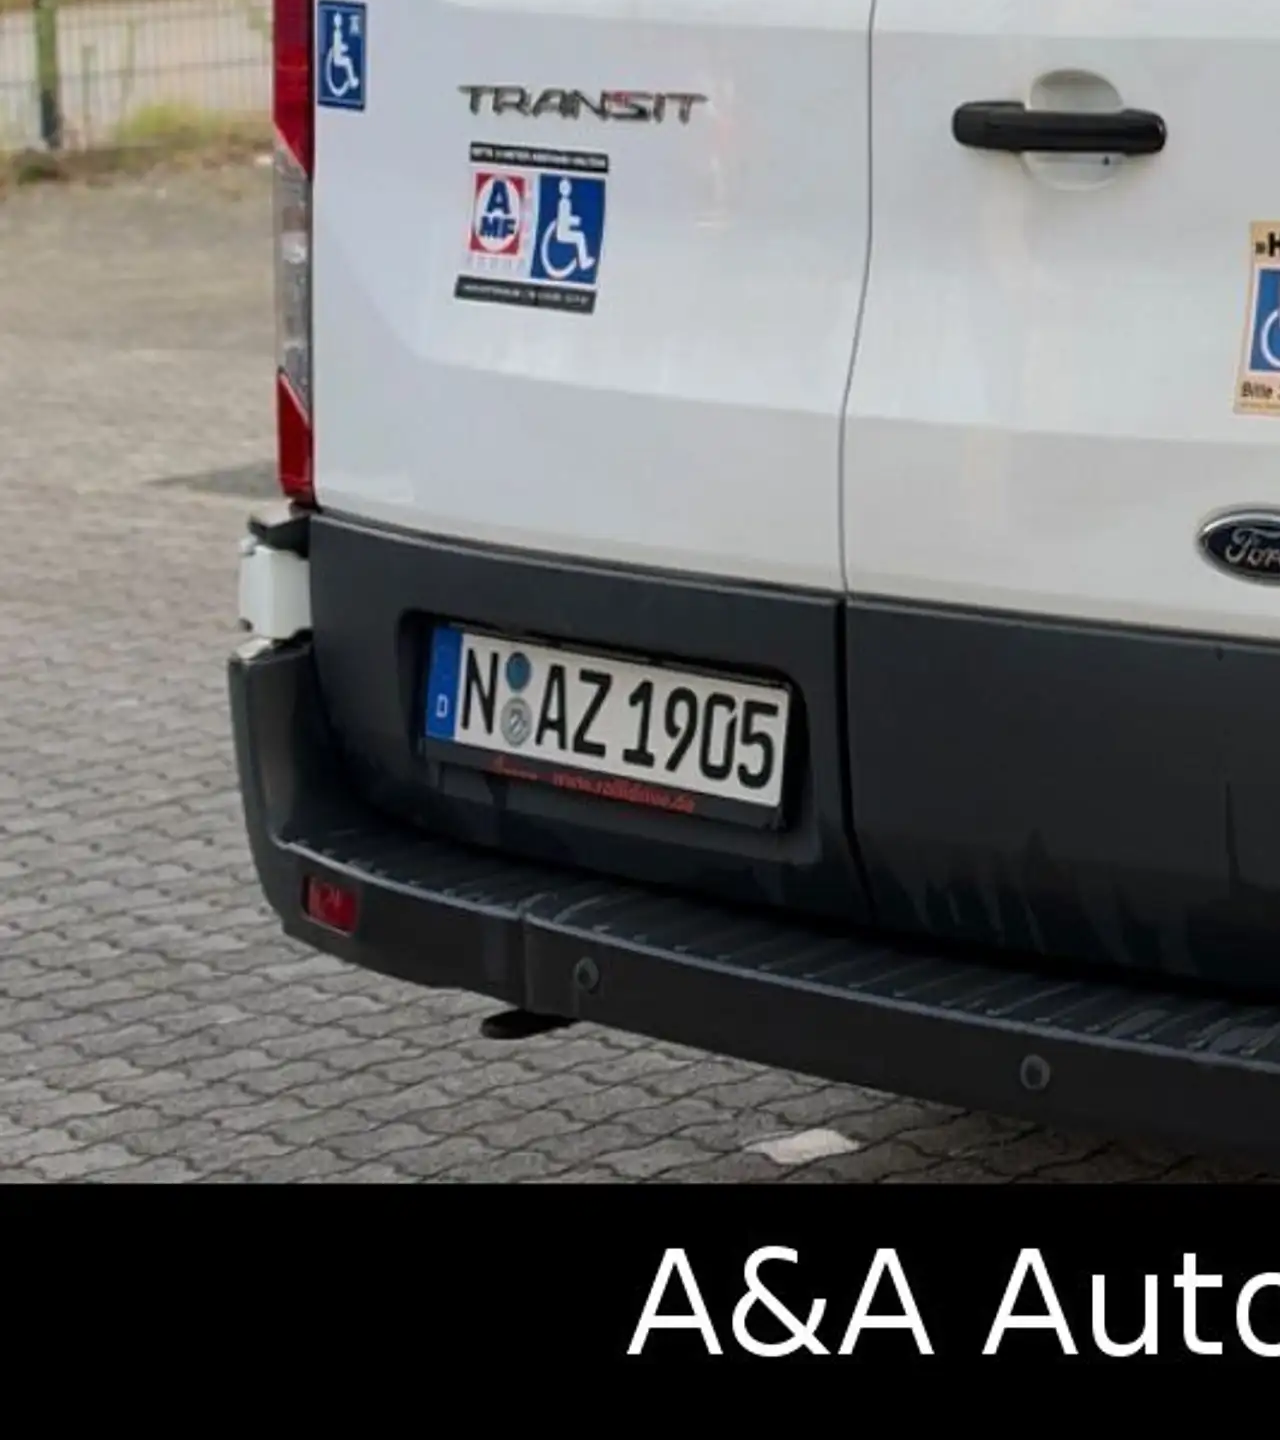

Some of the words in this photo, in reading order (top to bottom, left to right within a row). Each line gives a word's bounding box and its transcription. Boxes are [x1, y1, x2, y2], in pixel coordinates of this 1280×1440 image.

[457, 84, 708, 125] TRANSIT
[486, 179, 510, 215] A
[479, 214, 516, 240] MF
[435, 693, 449, 719] D
[460, 648, 500, 736] N
[621, 679, 780, 791] 1905
